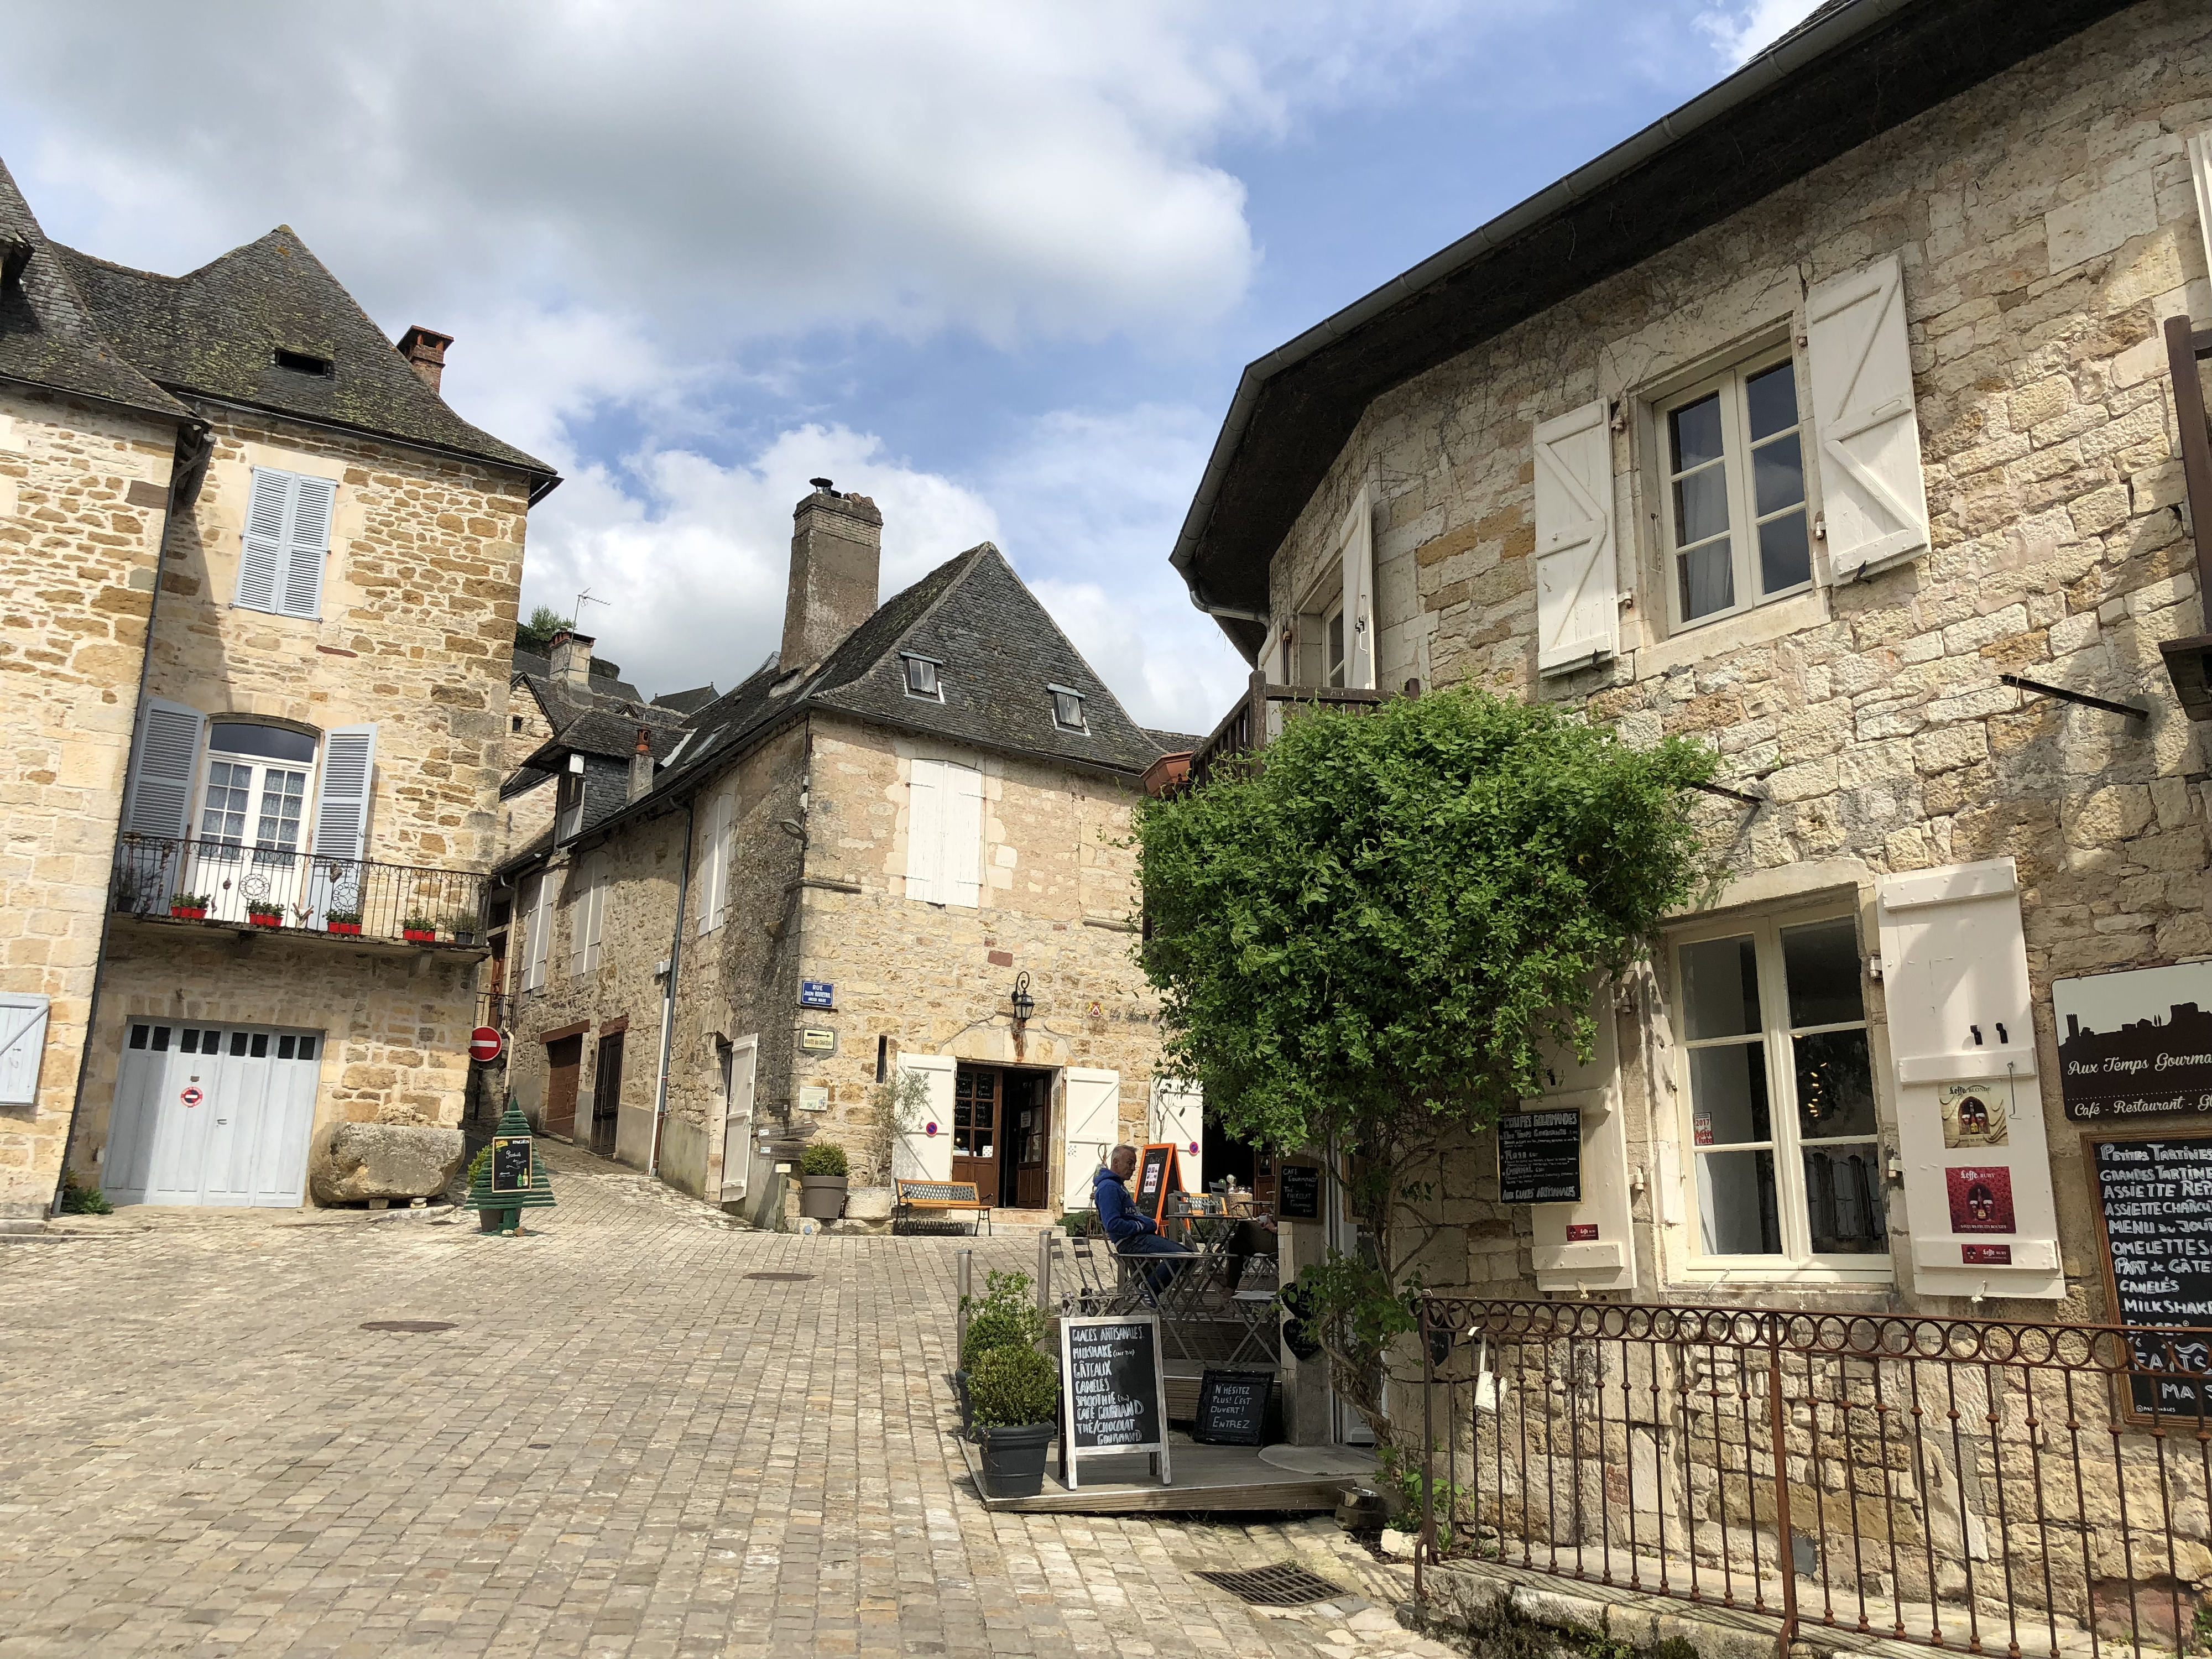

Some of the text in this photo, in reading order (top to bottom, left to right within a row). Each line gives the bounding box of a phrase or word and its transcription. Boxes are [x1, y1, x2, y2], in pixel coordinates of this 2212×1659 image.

[2067, 1061, 2099, 1075] Aux
[2103, 1057, 2149, 1075] Temps
[1949, 1086, 1966, 1096] Leffe
[2075, 1102, 2100, 1118] Café
[2114, 1095, 2185, 1114] Restaurant
[1961, 1170, 1978, 1181] Leffe
[2100, 1168, 2155, 1181] GRANDES
[2104, 1182, 2176, 1199] ASSIETTE
[2105, 1202, 2162, 1216] ASSIETTE
[2109, 1219, 2155, 1234] MENU
[2111, 1238, 2210, 1256] OMELETTES
[2115, 1257, 2148, 1275] PART
[2120, 1276, 2180, 1294] CANELÉS
[1072, 1328, 1097, 1342] GLACES
[1073, 1343, 1112, 1359] MILKSHAKE
[1073, 1360, 1112, 1379] GÂTEAUX
[1076, 1391, 1116, 1407] SMOOTHIE
[1077, 1399, 1144, 1420] CAFÉ GOURMAND
[1212, 1416, 1250, 1428] ENTREZ
[1097, 1430, 1142, 1445] GOURMAND
